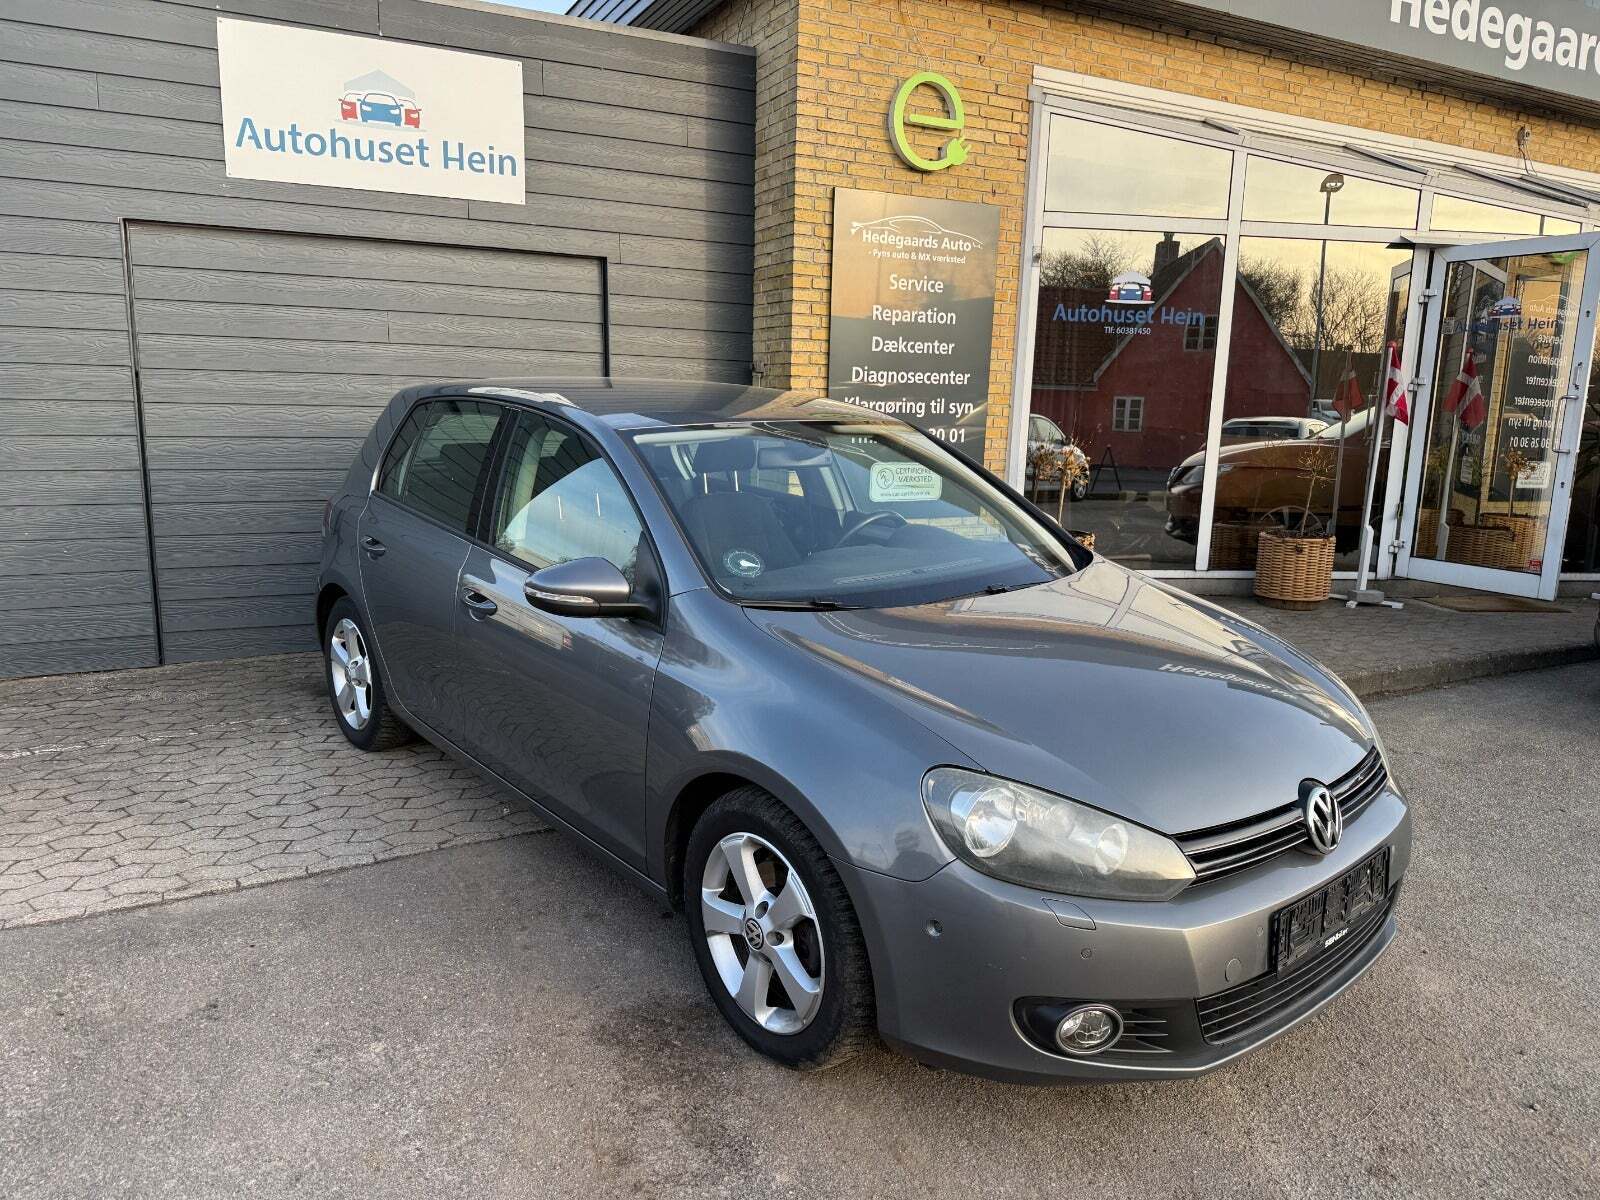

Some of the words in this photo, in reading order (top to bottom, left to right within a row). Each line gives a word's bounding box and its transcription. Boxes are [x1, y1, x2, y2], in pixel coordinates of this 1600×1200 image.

[1390, 0, 1600, 75] edegaar
[236, 117, 429, 168] Autohuset
[442, 140, 517, 177] Hein
[862, 230, 938, 248] Hedegaards
[941, 237, 972, 252] Auto
[889, 274, 944, 293] Service
[872, 305, 956, 325] Reparation
[1053, 304, 1155, 324] Autohuset
[1161, 306, 1206, 326] Hein
[871, 336, 955, 355] Dækcenter
[851, 366, 970, 387] Diagnosecenter
[930, 398, 944, 414] til
[949, 402, 974, 418] syn
[949, 428, 966, 443] 01
